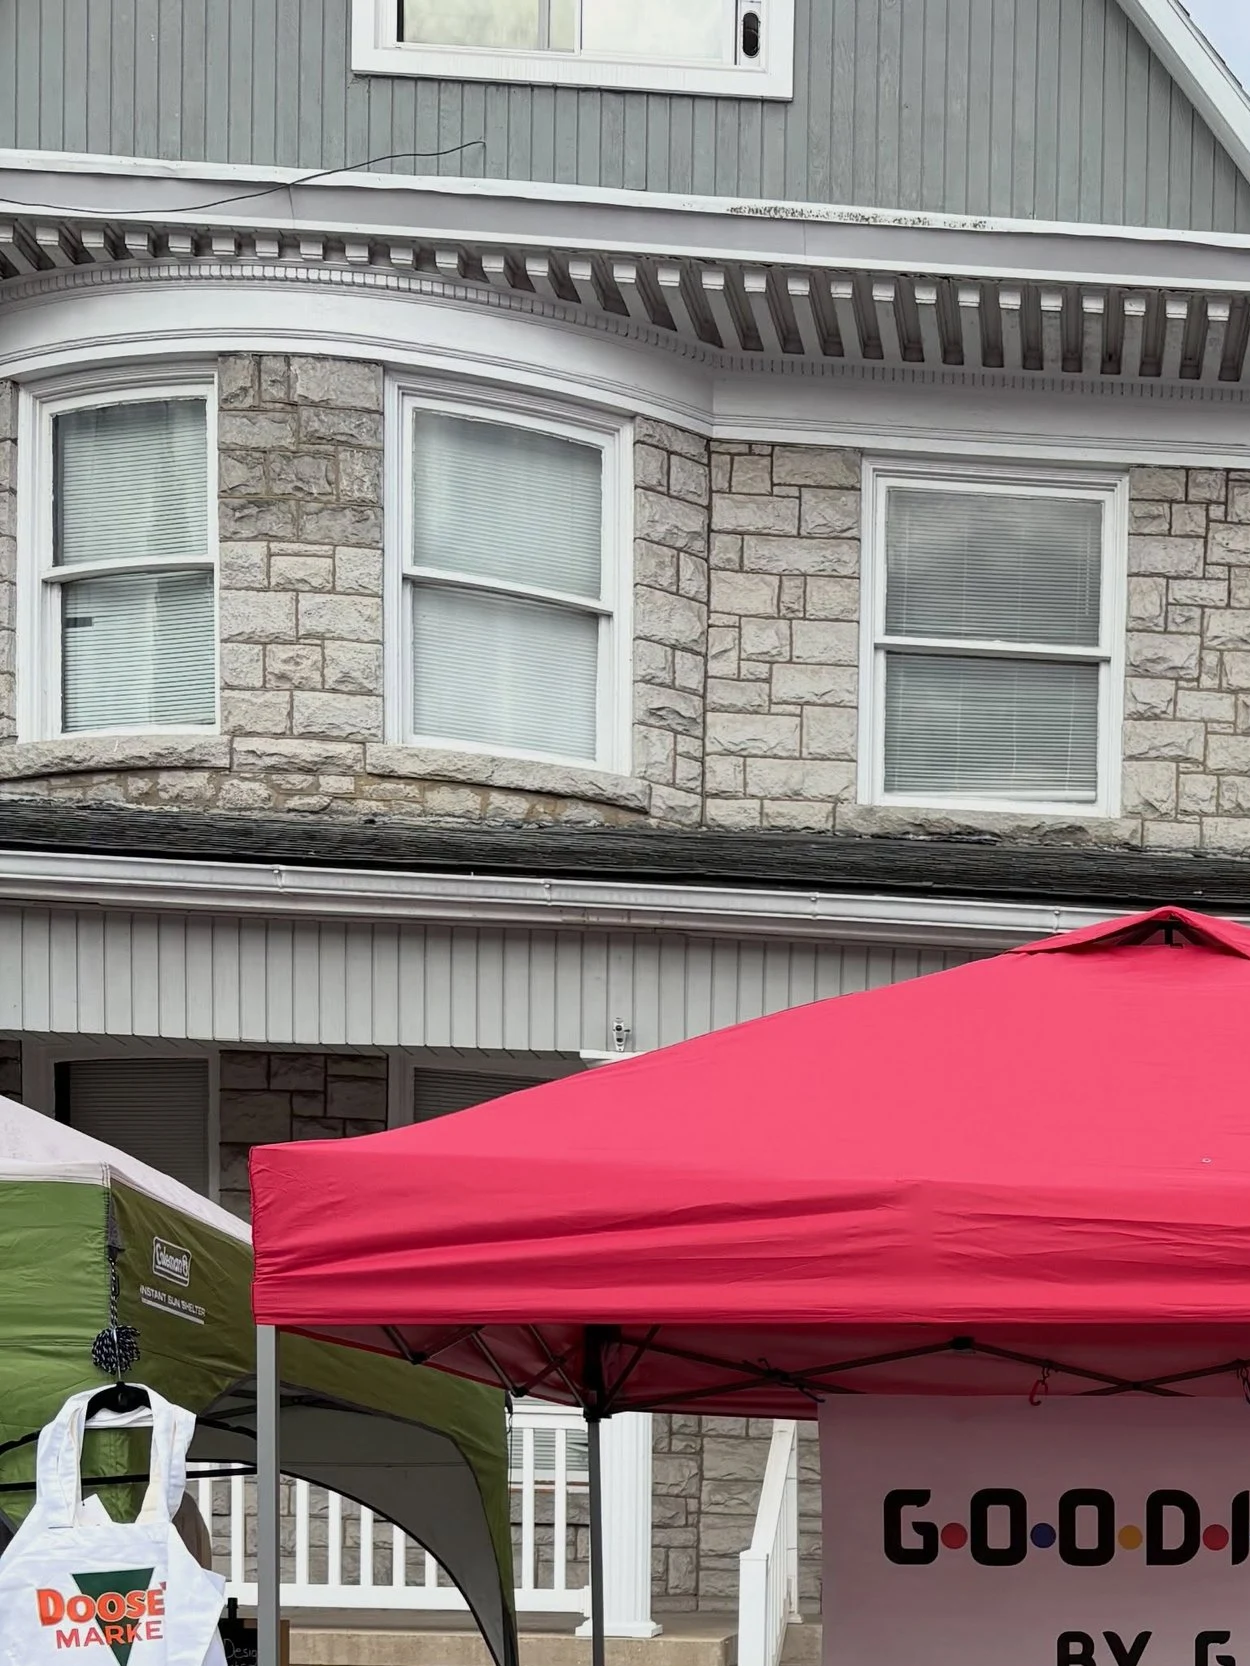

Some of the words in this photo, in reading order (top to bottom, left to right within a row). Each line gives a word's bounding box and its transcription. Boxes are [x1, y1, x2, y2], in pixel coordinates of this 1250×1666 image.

[155, 1243, 183, 1274] Coleman
[140, 1285, 166, 1302] INSTANT
[167, 1295, 180, 1308] SUN
[181, 1300, 206, 1317] SHELTER
